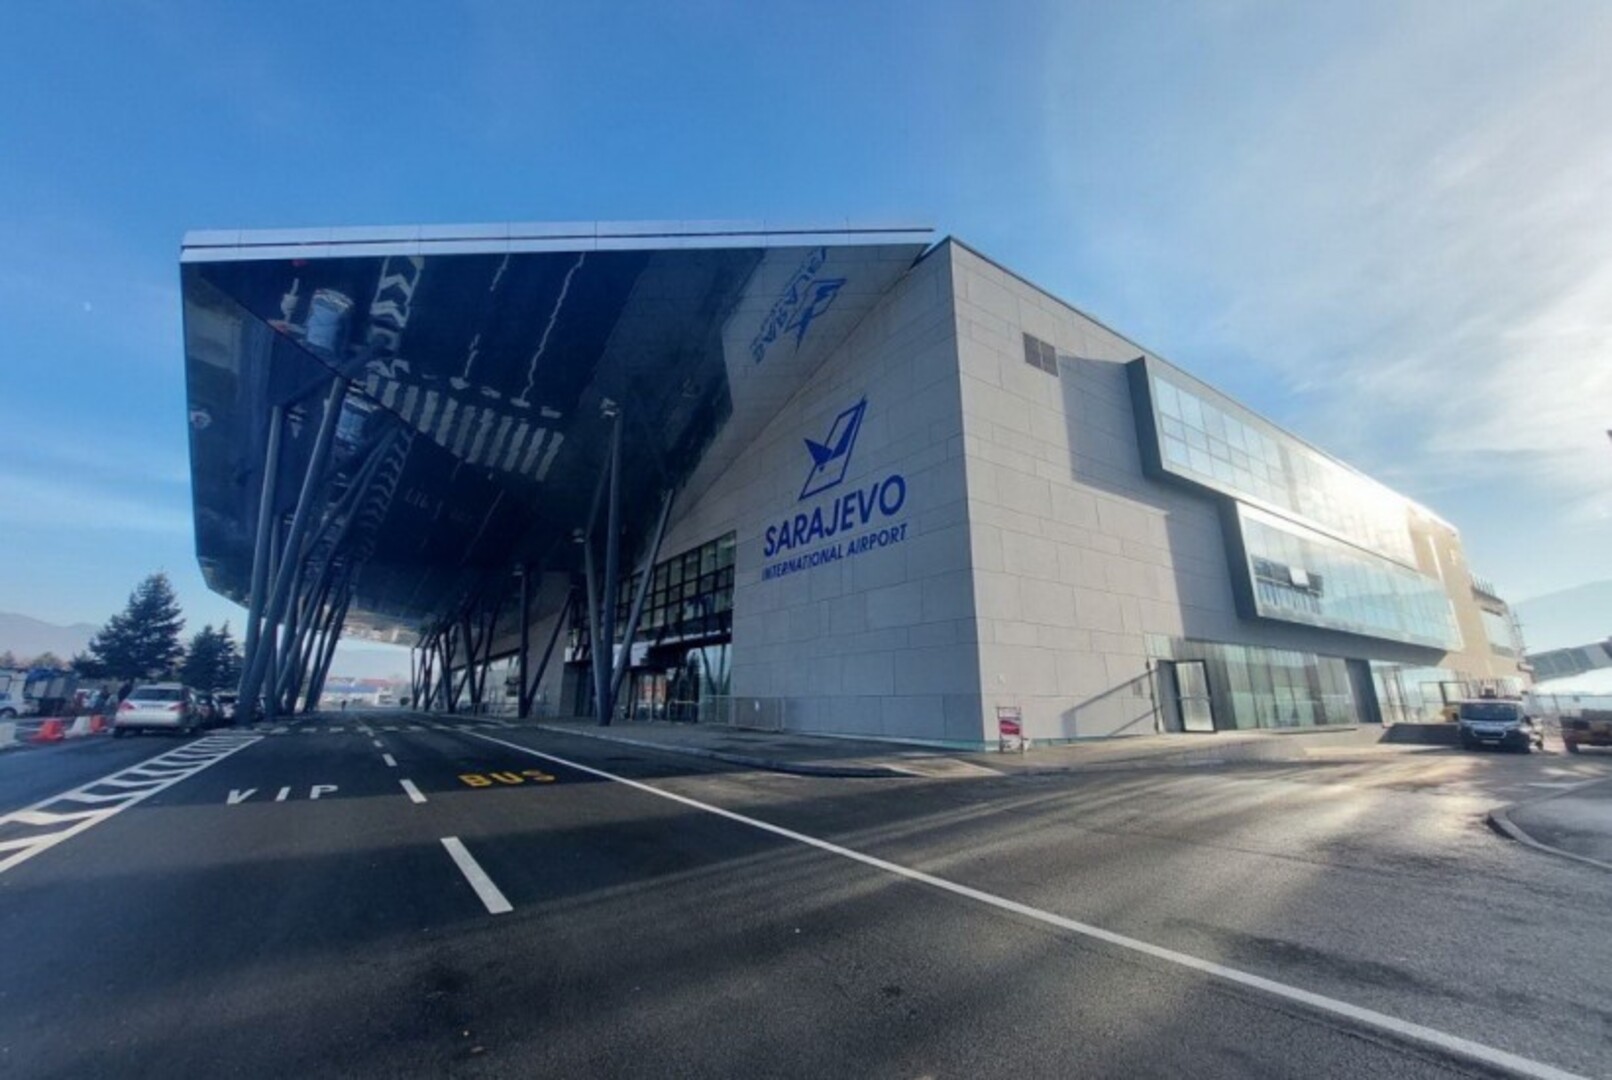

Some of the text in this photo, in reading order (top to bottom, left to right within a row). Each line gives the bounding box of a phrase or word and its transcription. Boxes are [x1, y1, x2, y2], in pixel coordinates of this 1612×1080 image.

[764, 475, 906, 557] SARAJEVO
[762, 523, 907, 580] INTERNATIONAL AIRPORT
[227, 785, 339, 804] VIP
[459, 770, 556, 787] BUS
